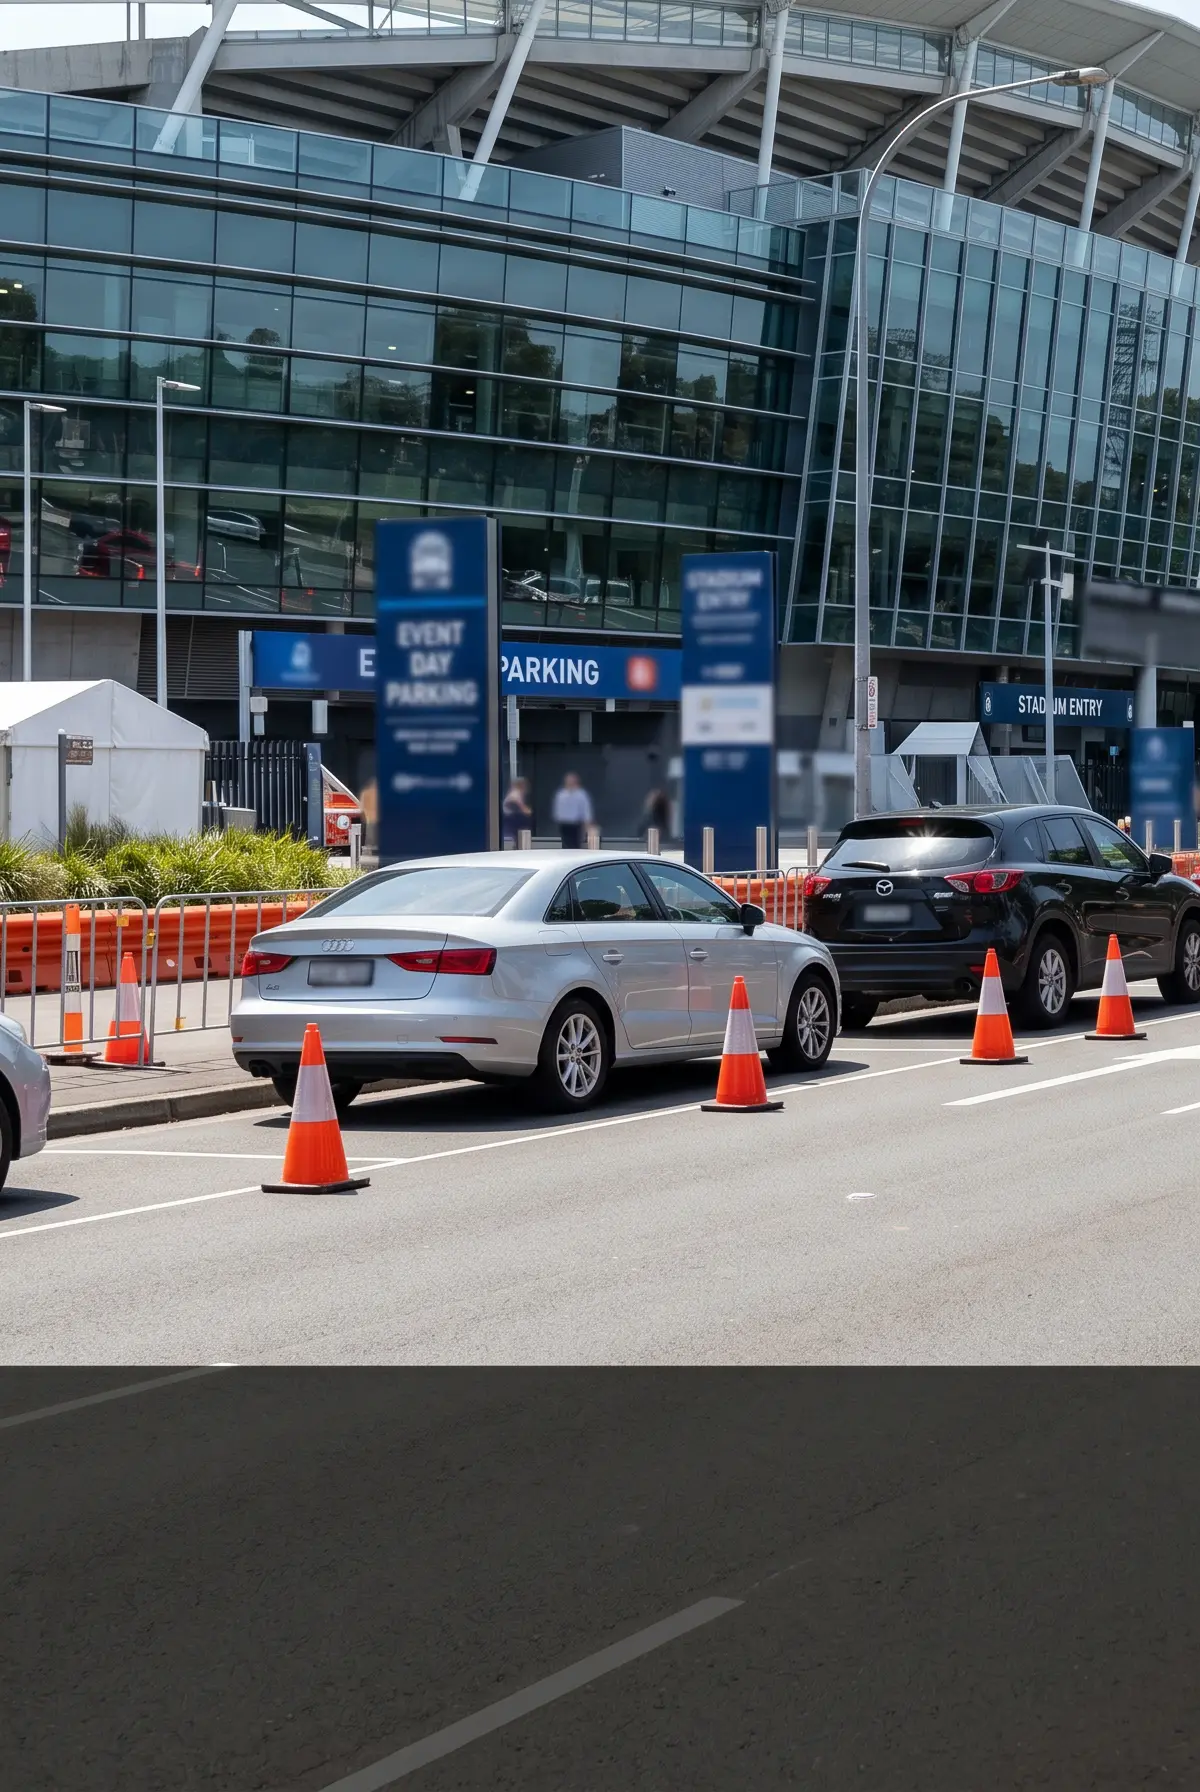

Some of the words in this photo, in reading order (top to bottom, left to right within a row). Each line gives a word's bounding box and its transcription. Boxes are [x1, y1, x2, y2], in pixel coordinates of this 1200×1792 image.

[397, 620, 465, 647] EVENT
[410, 651, 451, 676] DAY
[386, 681, 477, 706] PARKING
[1018, 695, 1067, 715] STADUM
[1069, 698, 1103, 716] ENTRY
